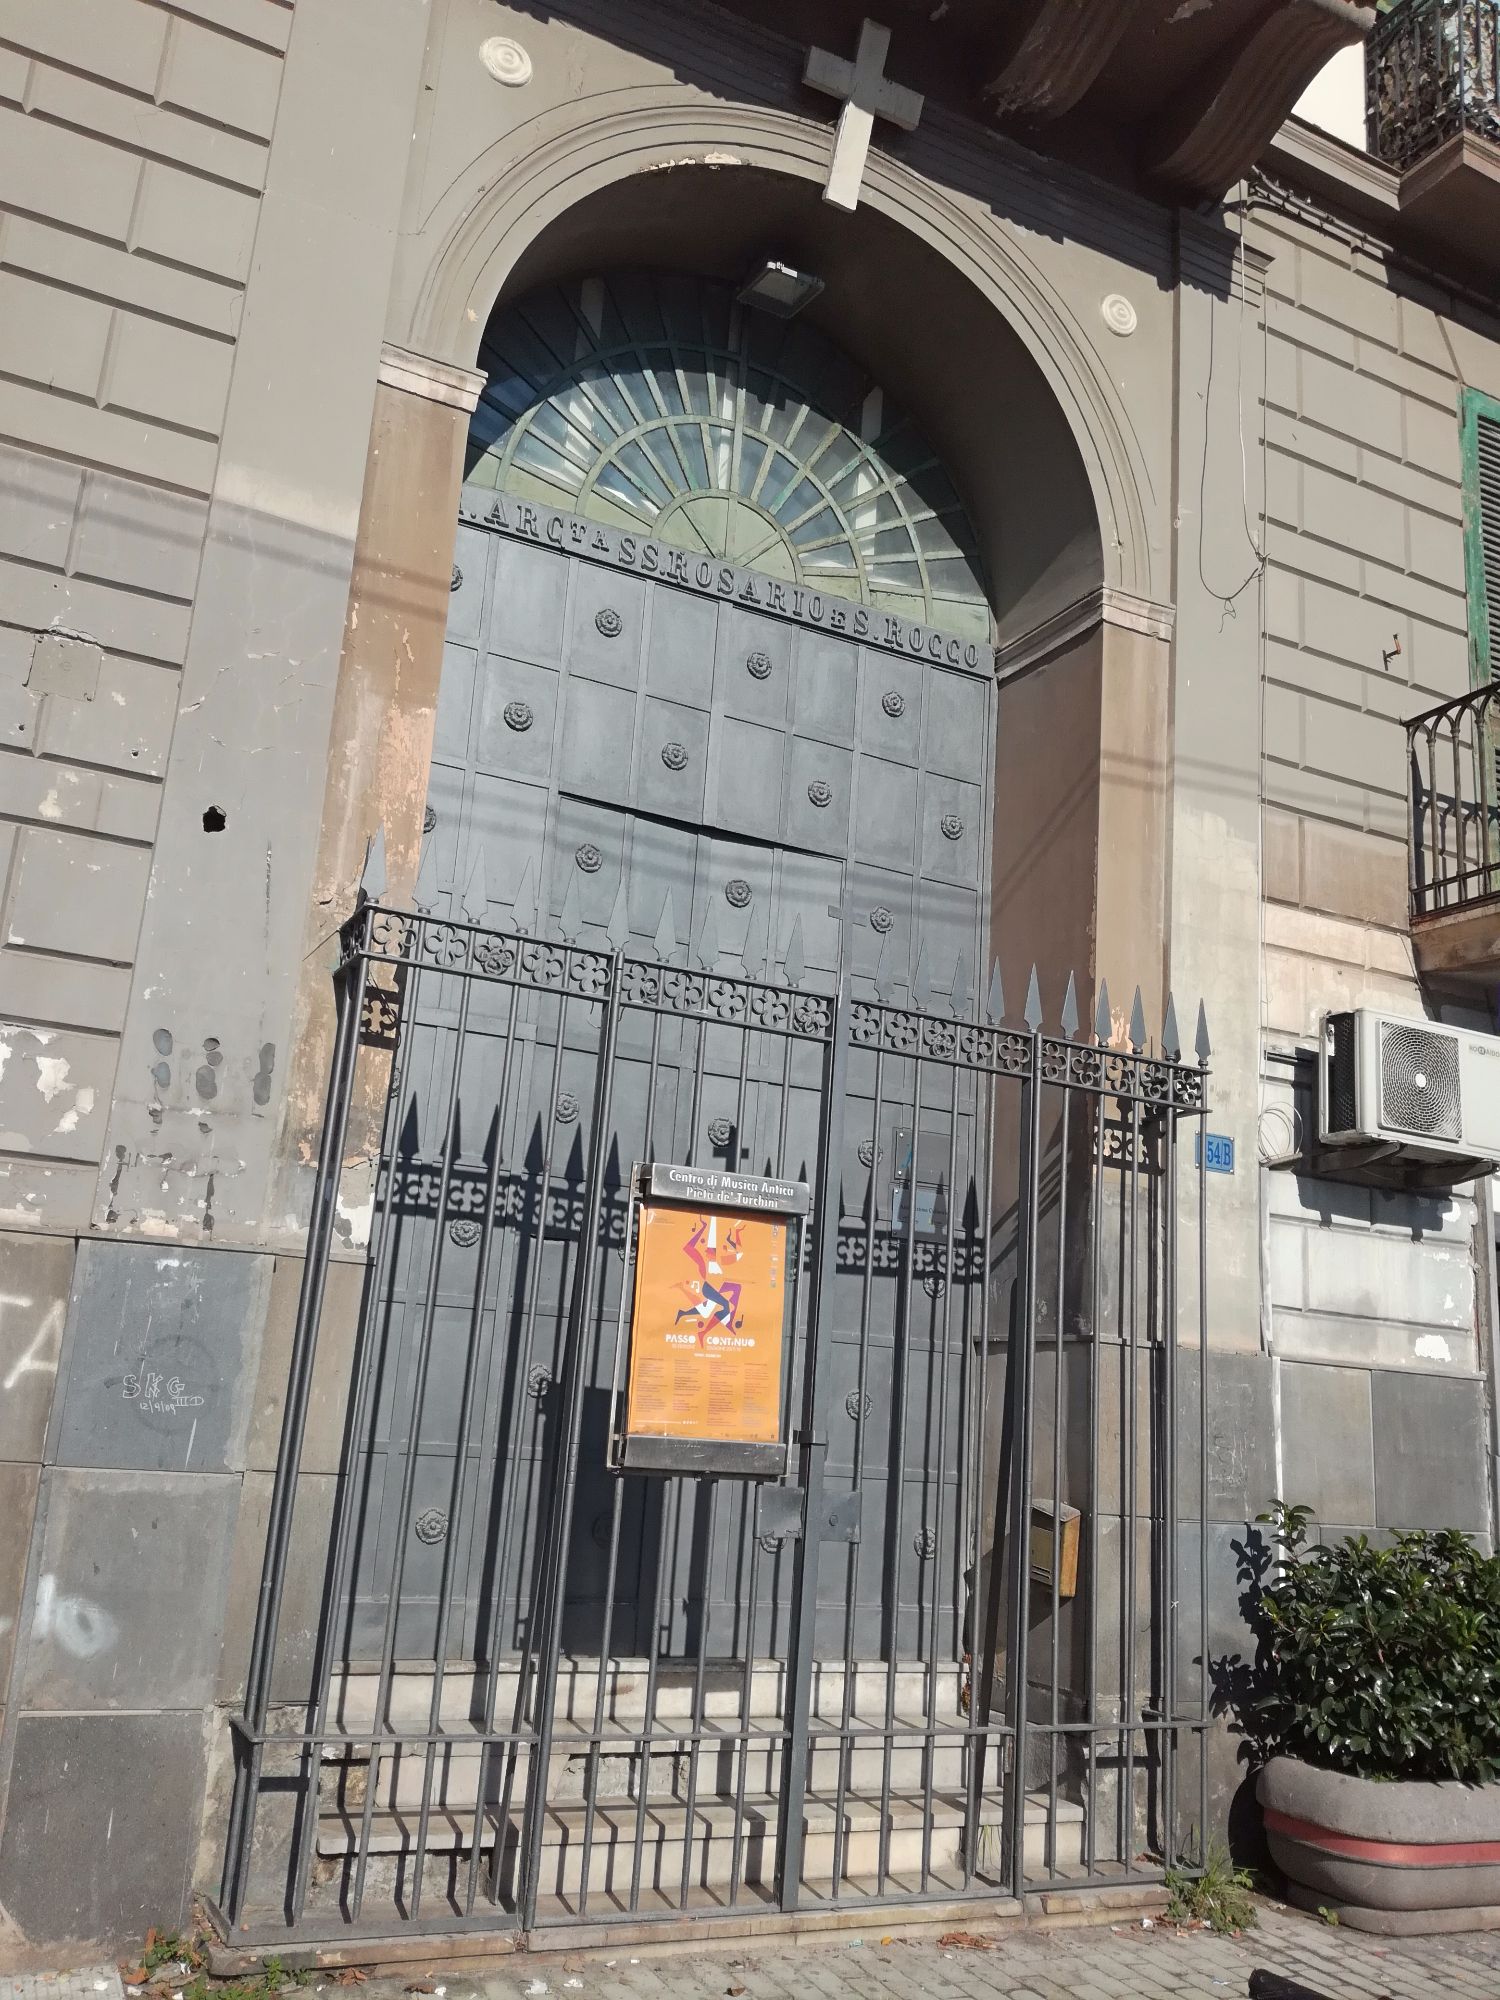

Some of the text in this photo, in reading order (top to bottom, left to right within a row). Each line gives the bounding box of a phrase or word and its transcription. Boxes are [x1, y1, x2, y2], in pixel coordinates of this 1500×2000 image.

[669, 1169, 794, 1197] Centro di Musica Antica
[736, 1192, 779, 1208] Turchini
[665, 1333, 696, 1344] PASSO
